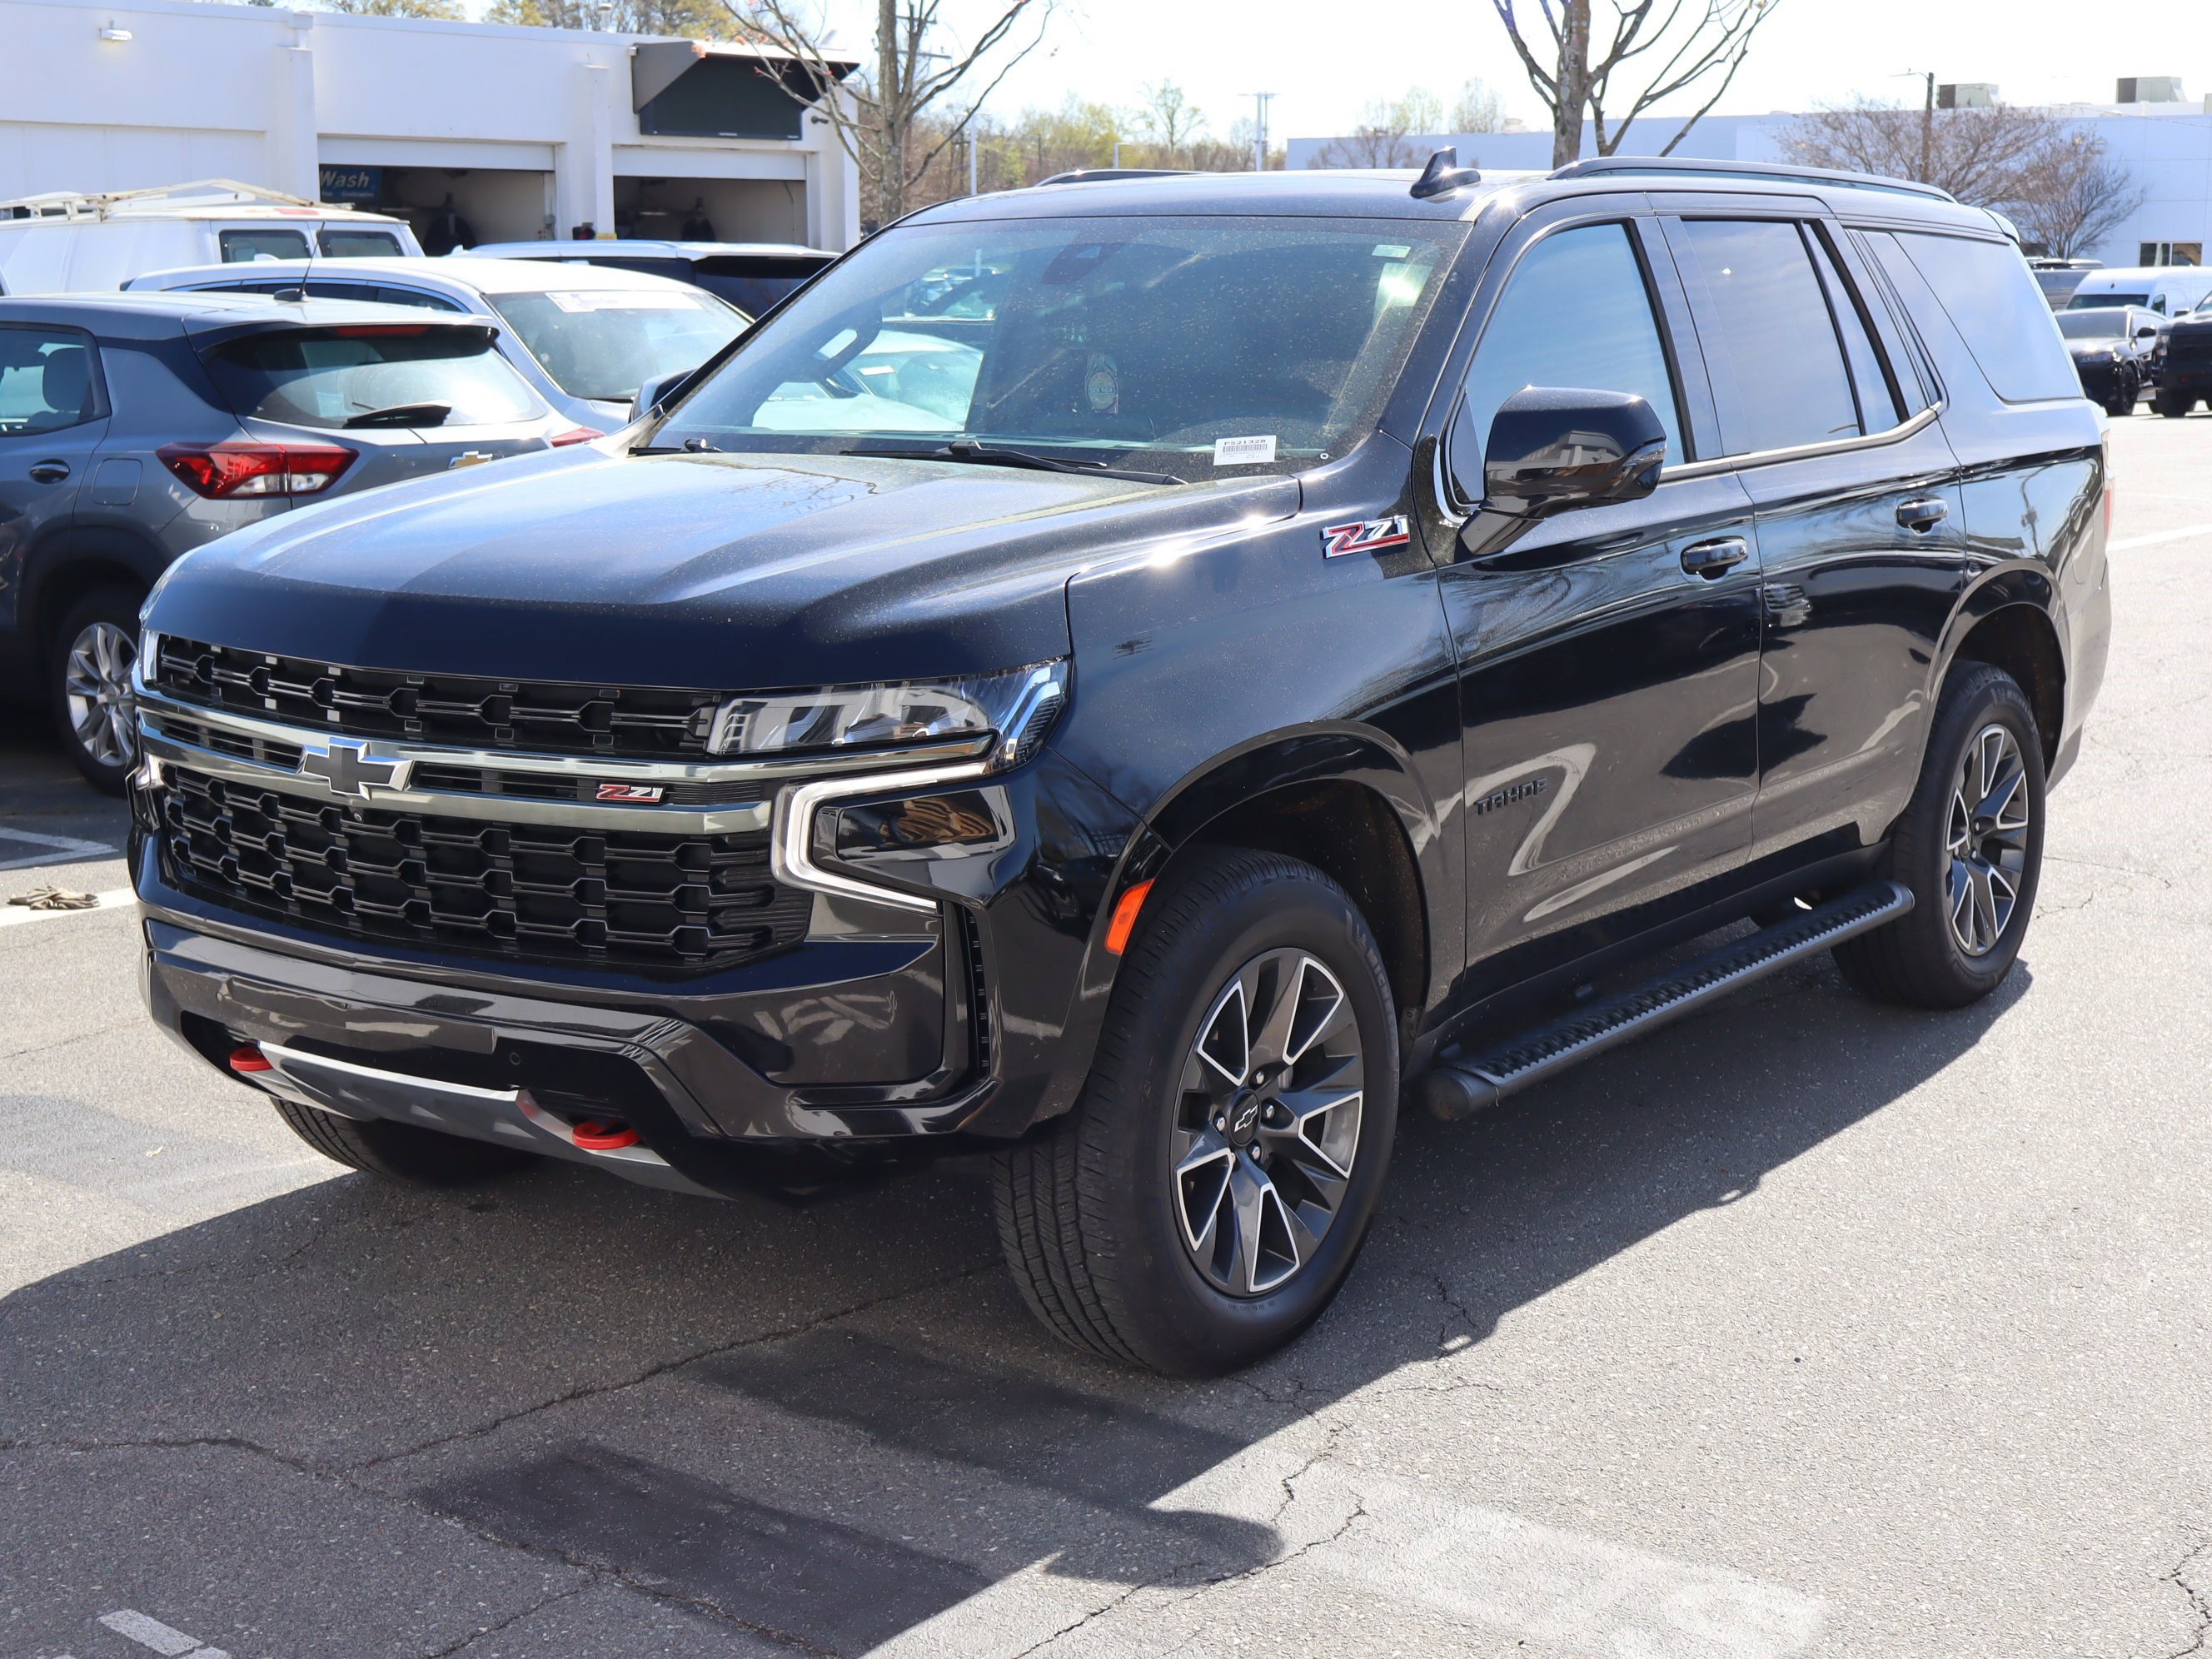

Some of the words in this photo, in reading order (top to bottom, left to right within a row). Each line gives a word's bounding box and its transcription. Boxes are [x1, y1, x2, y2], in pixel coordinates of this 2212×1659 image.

[320, 170, 369, 187] Wash
[1322, 515, 1410, 559] Z71
[596, 784, 664, 802] Z71
[1473, 777, 1547, 815] TAHOE
